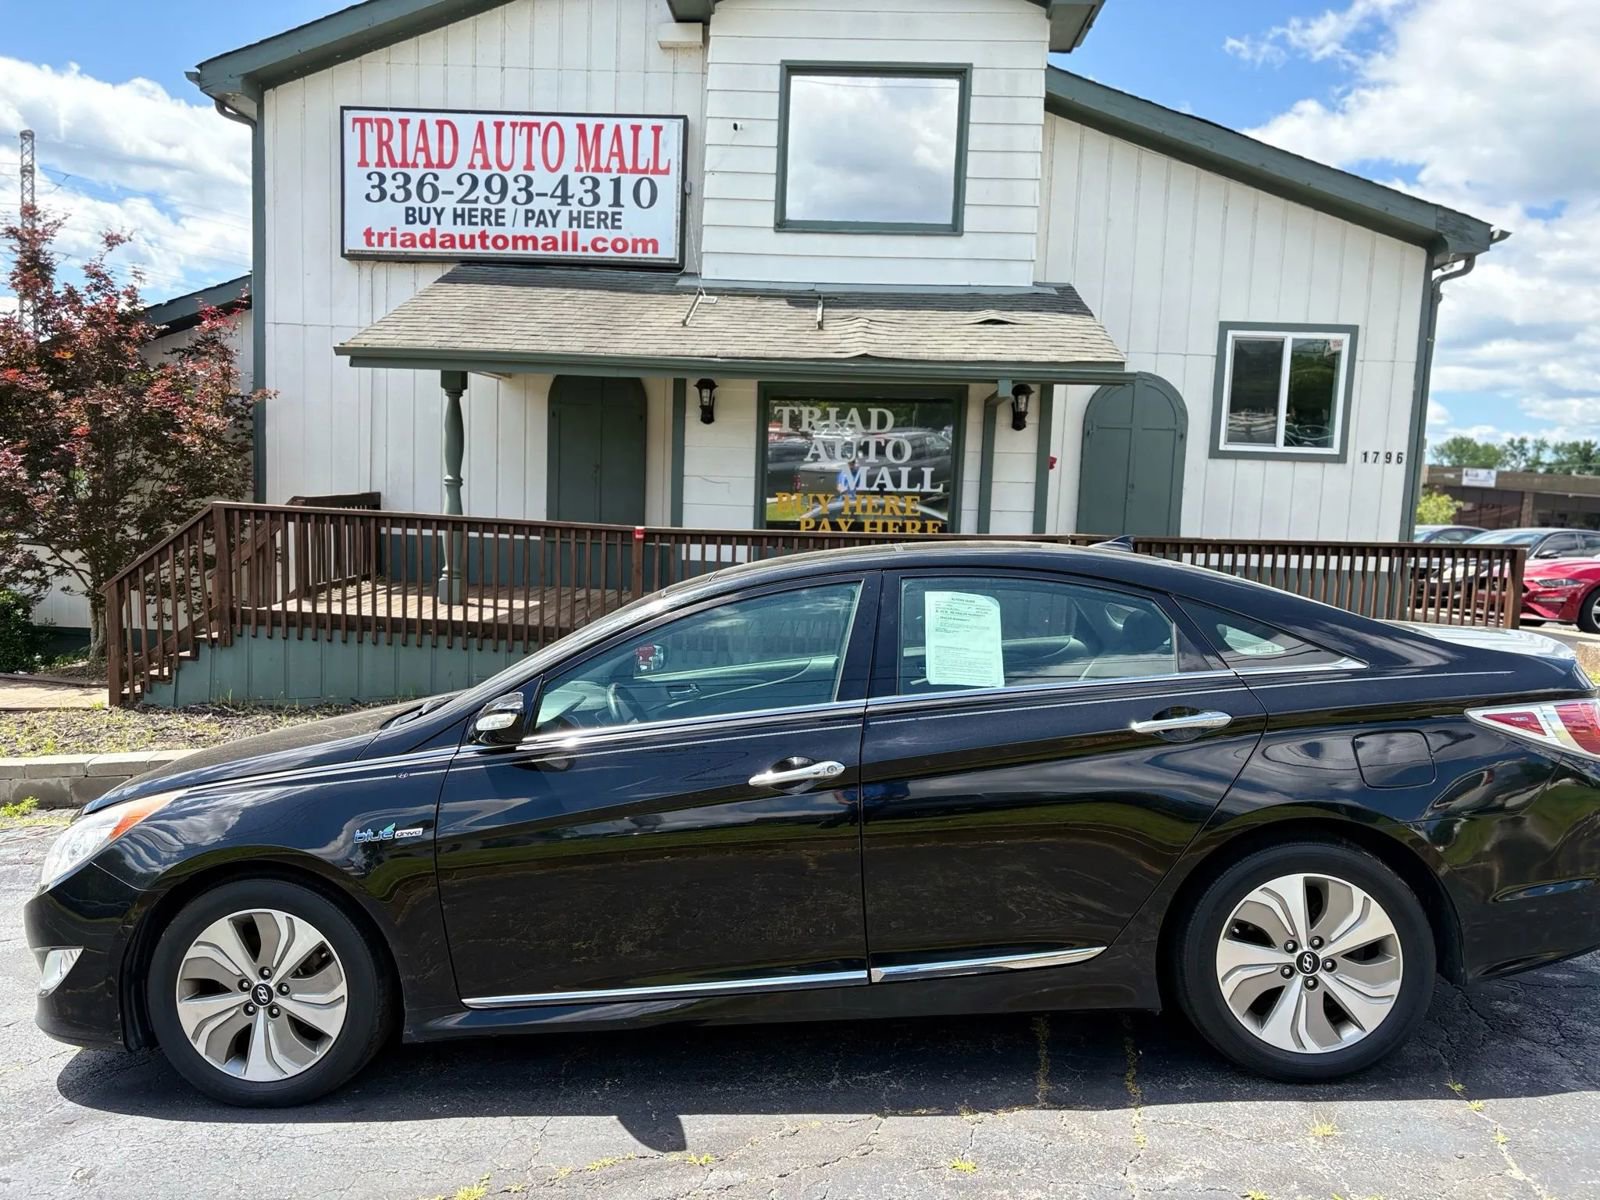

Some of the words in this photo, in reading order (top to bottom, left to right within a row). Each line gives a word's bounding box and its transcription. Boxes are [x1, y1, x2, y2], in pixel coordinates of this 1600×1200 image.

[352, 117, 459, 169] TRIAD
[467, 121, 566, 173] AUTO
[574, 123, 671, 175] MALL
[364, 171, 658, 208] 336-293-4310
[404, 206, 446, 226] BUY
[452, 208, 506, 227] HERE
[512, 208, 518, 228] /
[523, 209, 562, 229] PAY
[568, 210, 623, 230] HERE
[363, 227, 660, 254] triadautomall.com
[774, 406, 895, 433] TRIAD
[803, 437, 913, 463] AUTO
[1362, 451, 1404, 464] 1796
[840, 466, 943, 492] MALL
[775, 492, 834, 515] BUY
[841, 495, 921, 516] HERE
[800, 518, 855, 533] PAY
[864, 519, 942, 534] HERE
[354, 823, 395, 843] blue
